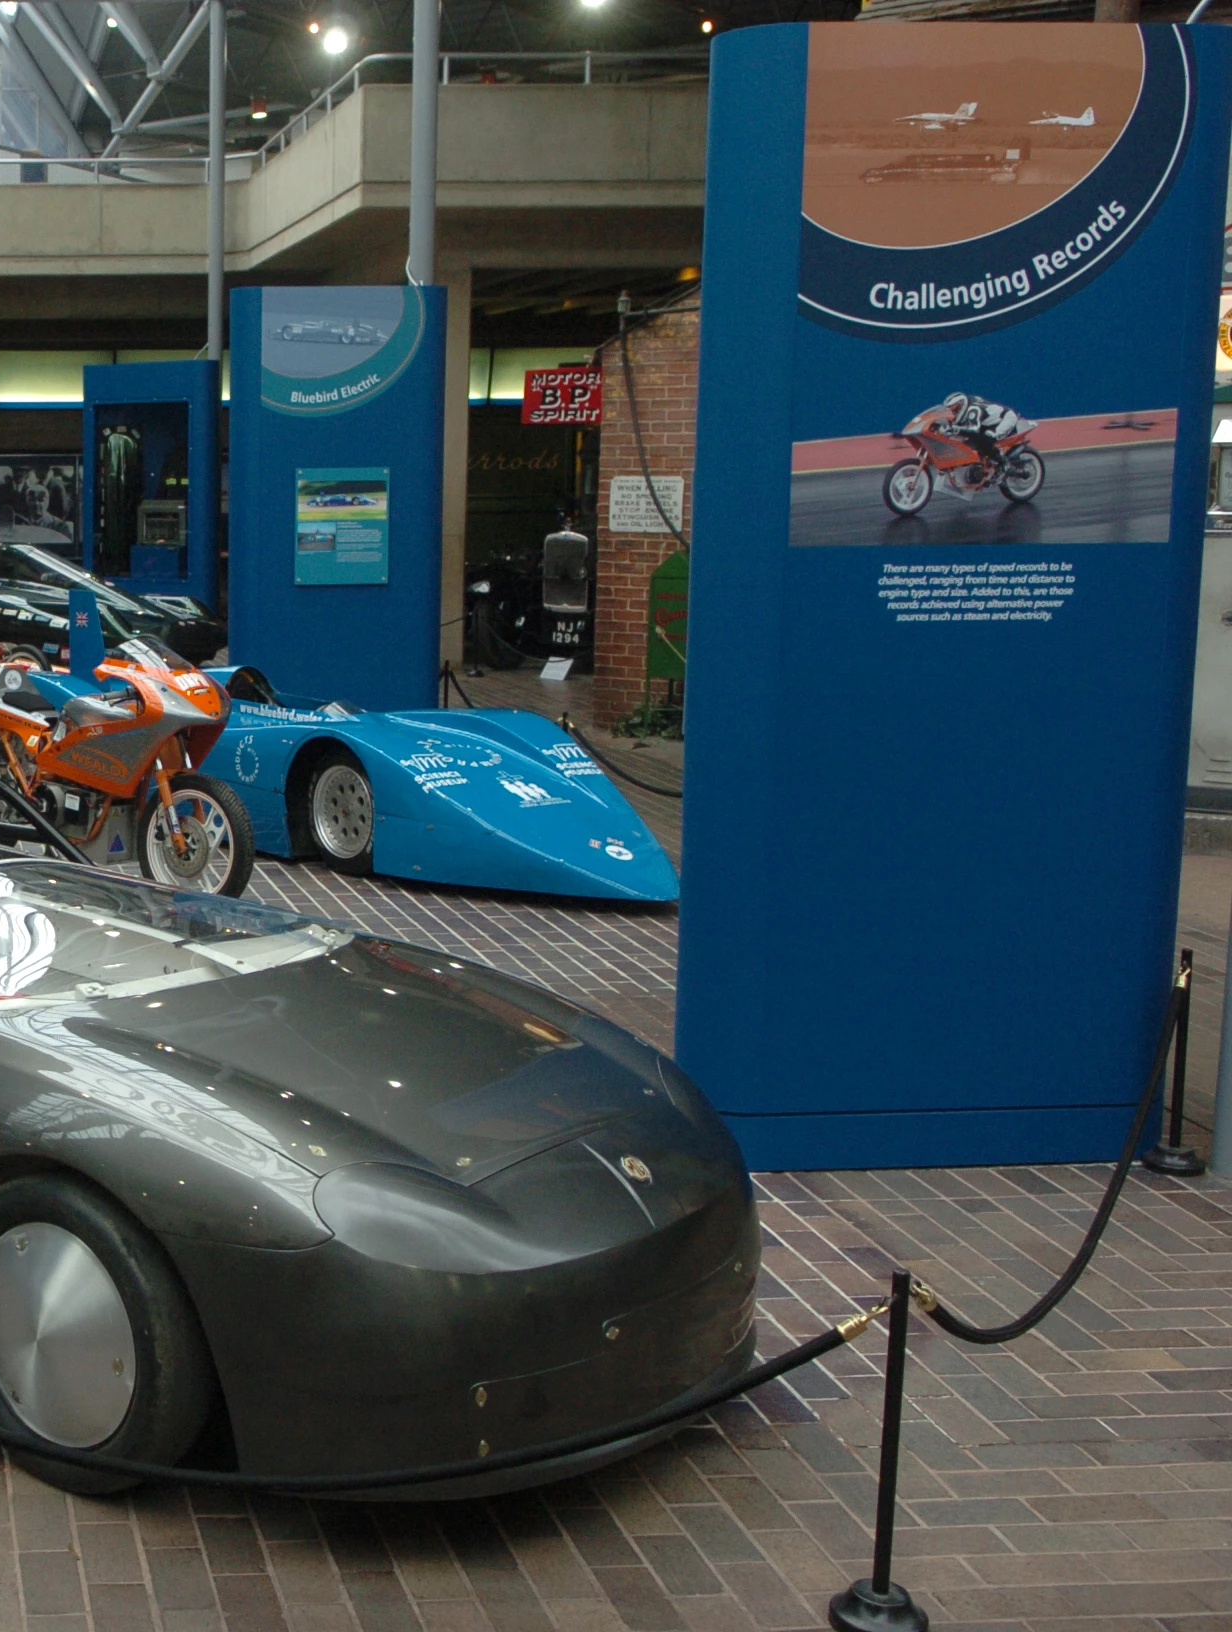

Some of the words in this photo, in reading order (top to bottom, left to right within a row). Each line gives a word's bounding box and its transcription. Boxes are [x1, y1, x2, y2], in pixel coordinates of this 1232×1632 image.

[869, 269, 1032, 310] Challenging
[1032, 199, 1127, 280] Records
[531, 372, 601, 387] MOTOR
[290, 388, 339, 404] Bluebird
[340, 372, 381, 399] Electric
[530, 409, 600, 423] SPIRIT
[467, 448, 561, 471] rrods
[617, 484, 642, 492] WHEN
[883, 564, 908, 573] There
[909, 565, 924, 573] are
[925, 565, 951, 575] many
[952, 564, 976, 575] types
[977, 562, 989, 572] of
[989, 562, 1016, 573] speed
[1016, 562, 1048, 572] records
[1049, 563, 1059, 571] to
[1060, 562, 1073, 571] be
[878, 576, 928, 587] challenged,
[929, 576, 963, 586] ranging
[965, 575, 987, 584] from
[988, 575, 1008, 584] time
[1009, 574, 1028, 583] and
[1028, 574, 1064, 584] distance
[1065, 574, 1076, 583] to
[878, 588, 909, 600] engine
[910, 588, 931, 599] type
[932, 588, 951, 597] and
[951, 588, 968, 597] size.
[971, 587, 1002, 596] Added
[1002, 587, 1012, 596] to
[1013, 586, 1031, 596] this,
[1033, 587, 1048, 596] are
[1049, 586, 1074, 596] those
[887, 600, 920, 610] records
[921, 599, 961, 609] achieved
[961, 599, 985, 610] using
[986, 599, 1033, 609] alternative
[1033, 600, 1065, 610] power
[896, 613, 929, 621] sources
[930, 612, 951, 621] such
[963, 612, 990, 620] steam
[991, 611, 1010, 620] and
[1010, 611, 1053, 622] electricity.
[557, 621, 574, 632] NJ
[552, 631, 579, 644] 1294
